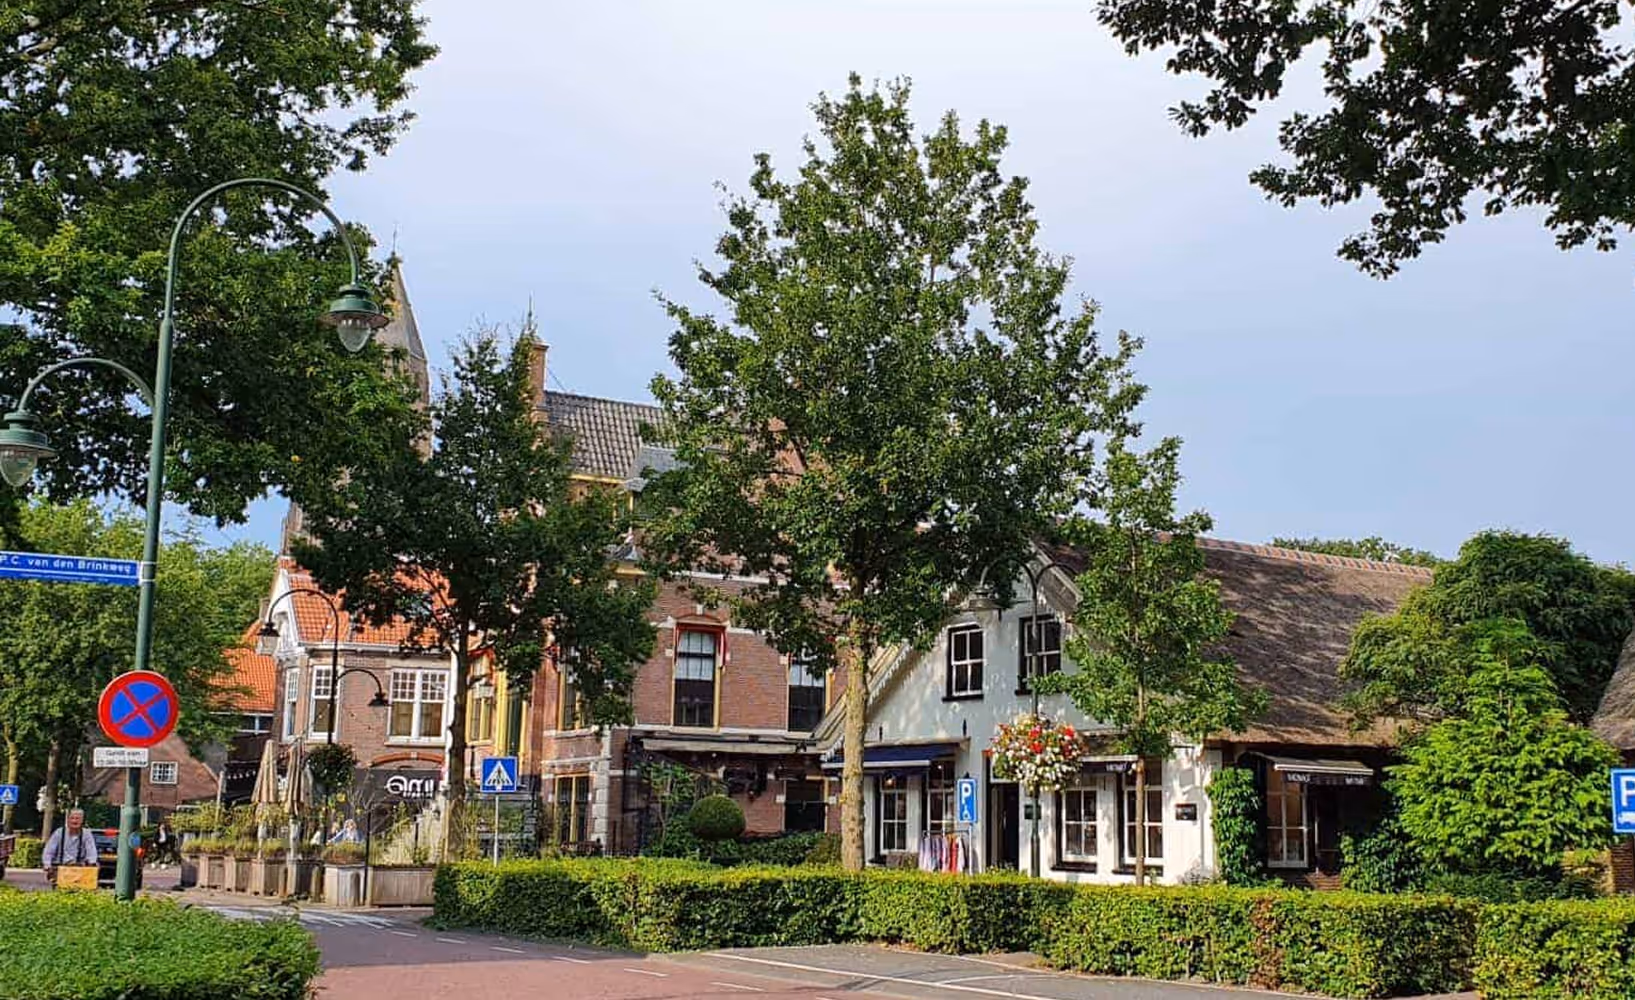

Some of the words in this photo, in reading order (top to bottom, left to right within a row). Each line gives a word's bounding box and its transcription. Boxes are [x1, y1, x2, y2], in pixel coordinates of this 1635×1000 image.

[28, 559, 49, 568] van
[53, 561, 74, 570] den
[77, 560, 132, 573] Brinkweg
[961, 782, 972, 805] P
[1621, 775, 1635, 807] P
